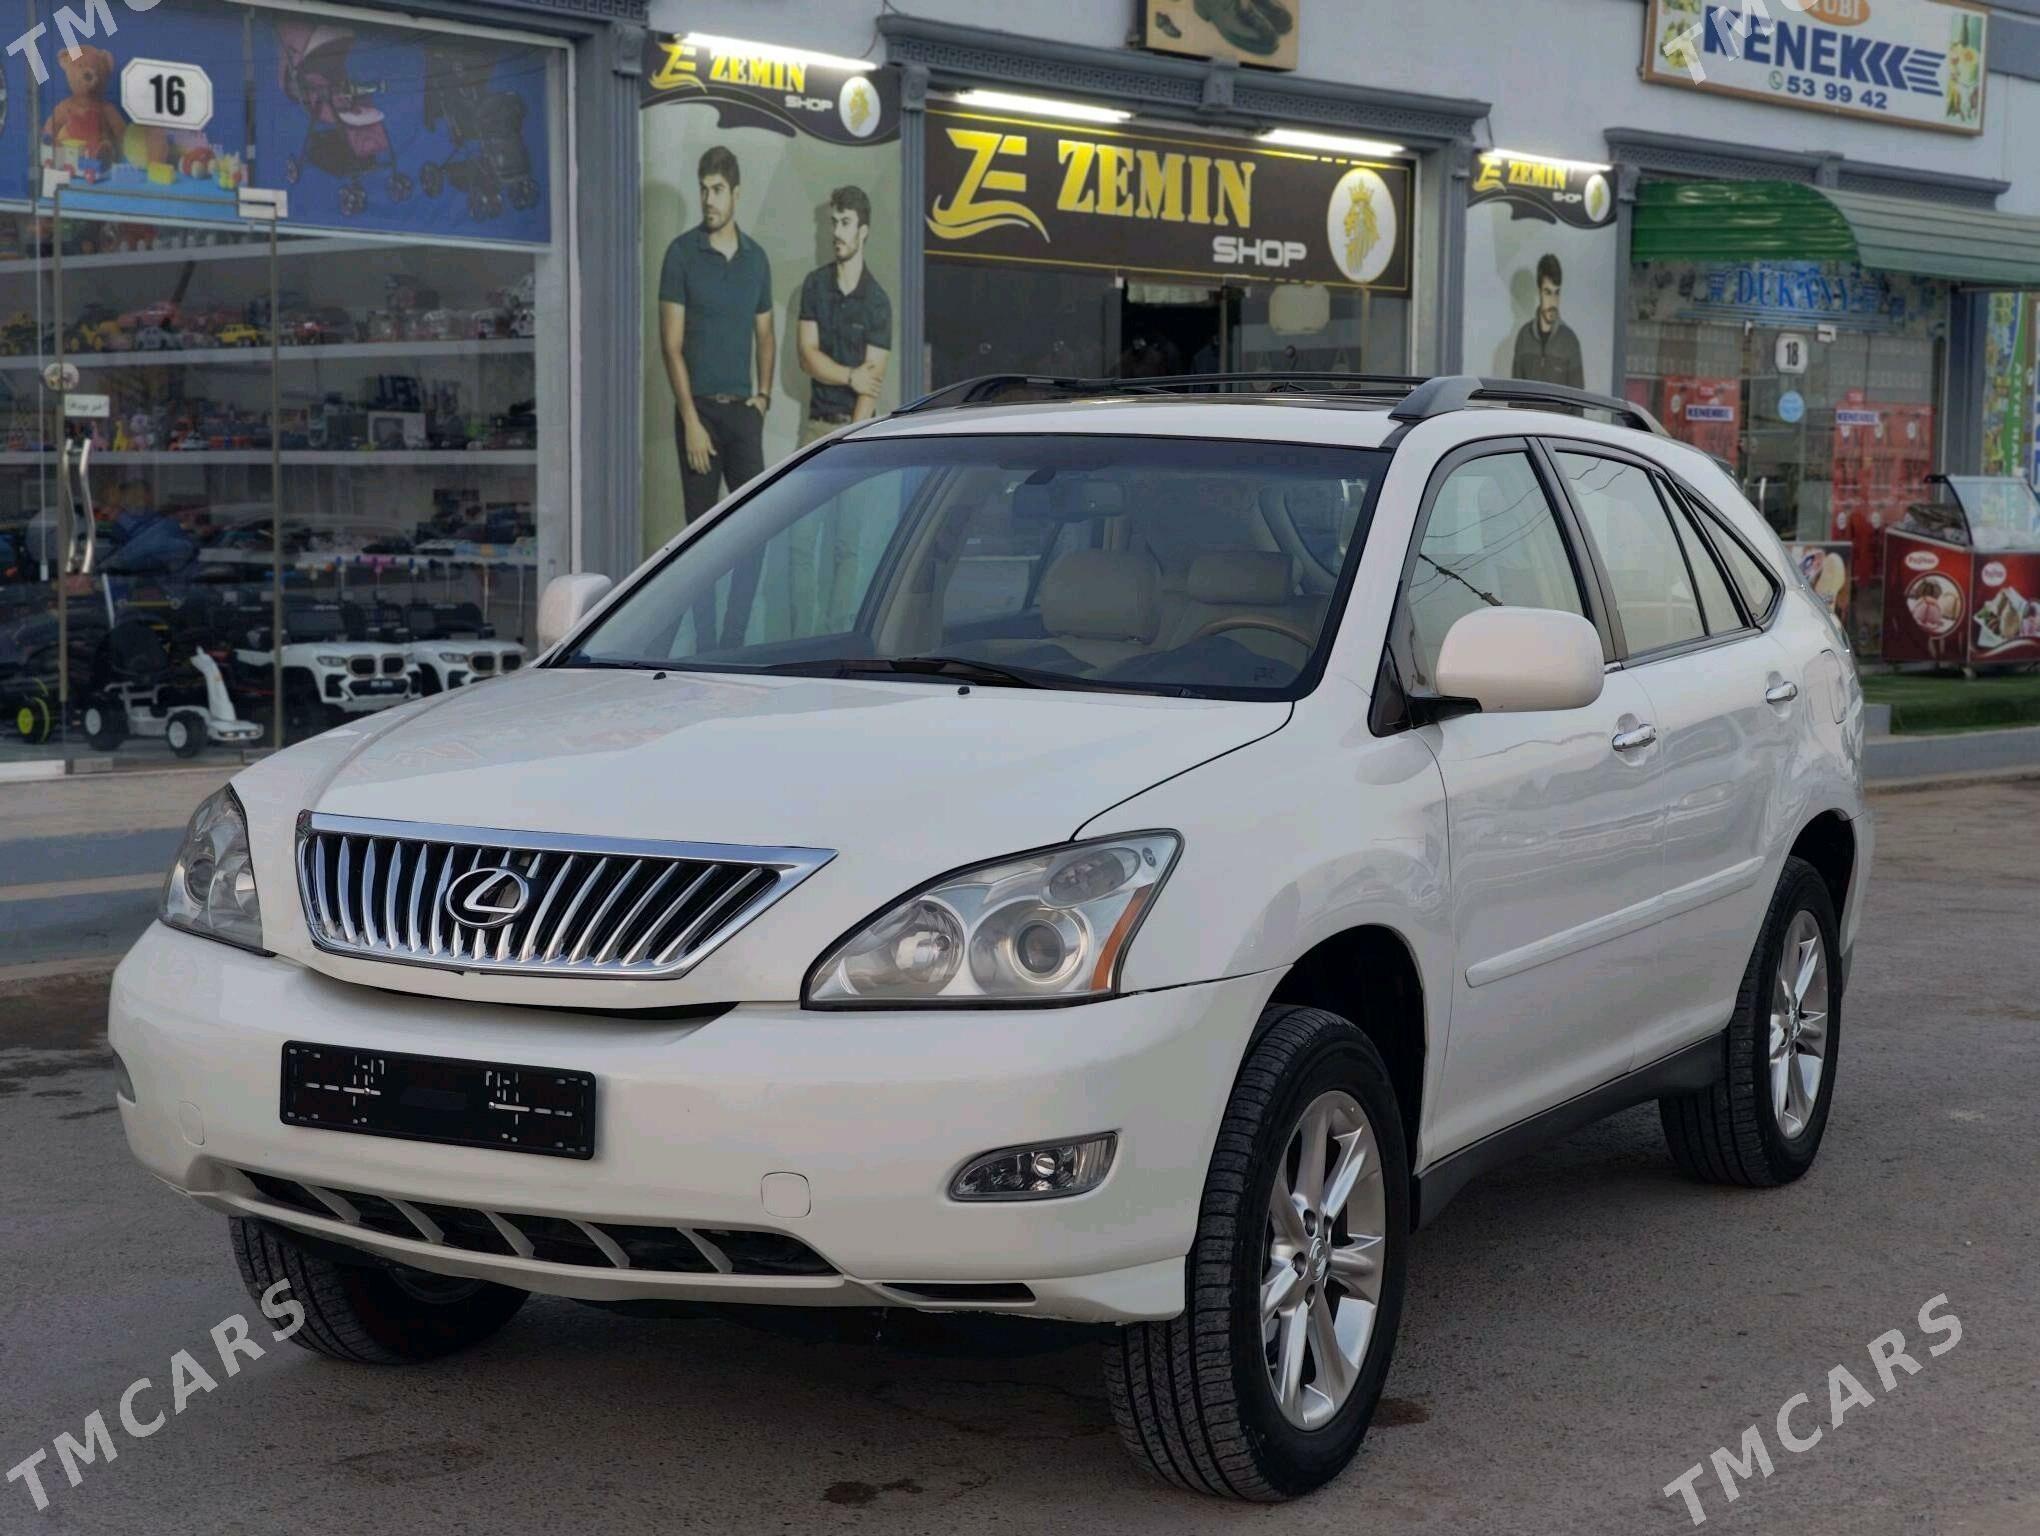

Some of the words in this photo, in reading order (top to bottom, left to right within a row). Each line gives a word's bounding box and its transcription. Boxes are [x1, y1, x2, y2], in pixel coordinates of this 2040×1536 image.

[709, 52, 806, 94] ZEMIN
[149, 74, 186, 116] 16
[785, 95, 833, 112] SHOP
[1787, 75, 1816, 98] 53
[1825, 82, 1853, 104] 99
[1859, 89, 1888, 110] 42
[1057, 139, 1257, 229] ZEMIN
[1508, 159, 1567, 190] ZEMIN
[1213, 236, 1307, 268] SHOP
[1785, 342, 1799, 366] 18
